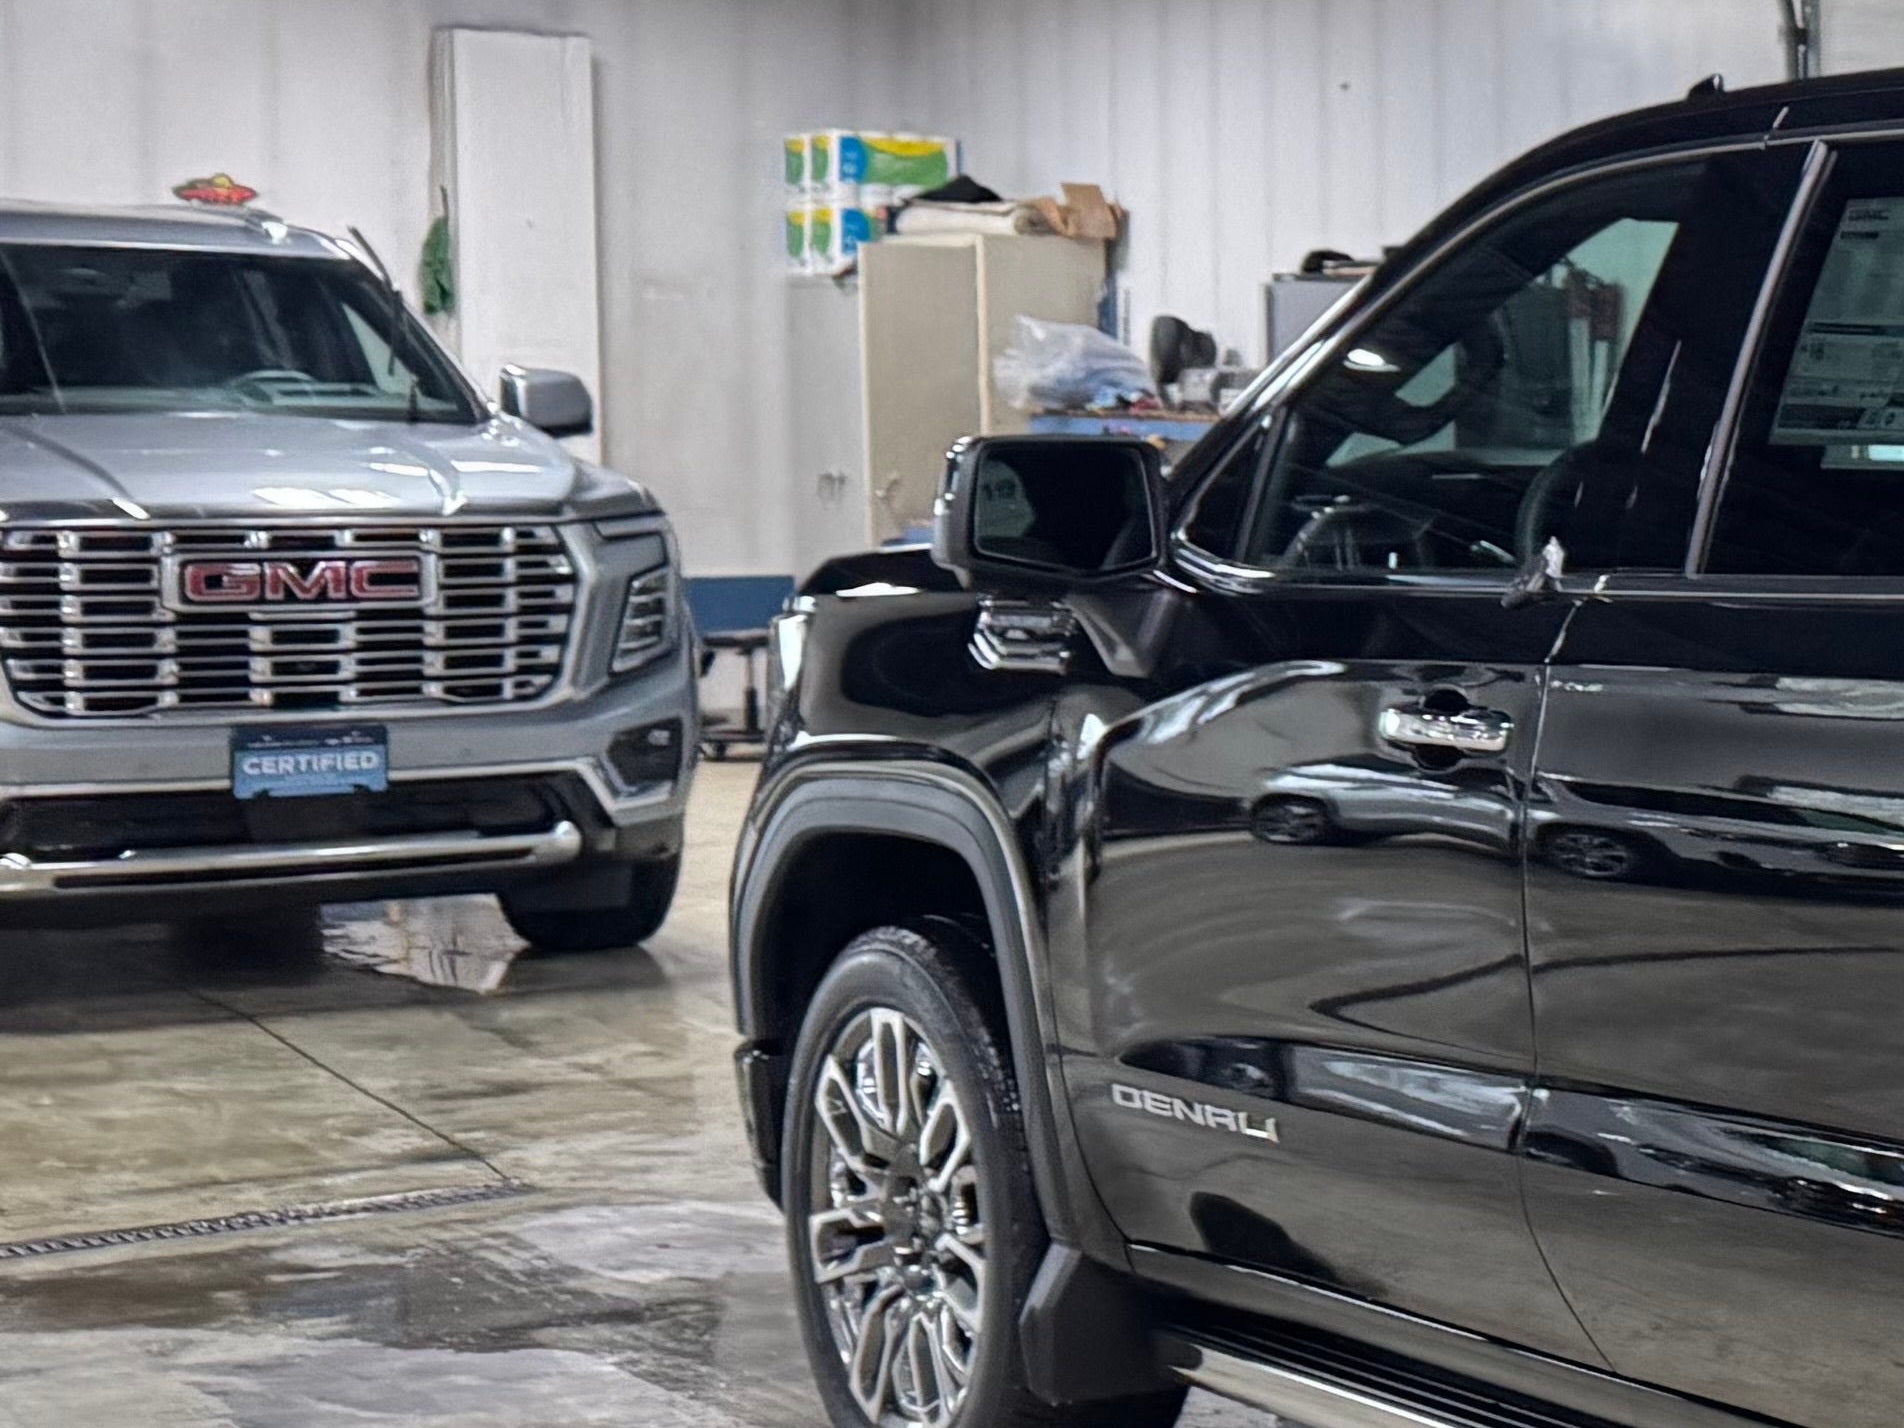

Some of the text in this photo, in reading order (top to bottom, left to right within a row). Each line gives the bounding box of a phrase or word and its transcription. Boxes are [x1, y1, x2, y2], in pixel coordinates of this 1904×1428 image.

[184, 559, 419, 602] GMC
[242, 750, 381, 776] CERTIFIED
[1111, 1083, 1280, 1144] DENALI
